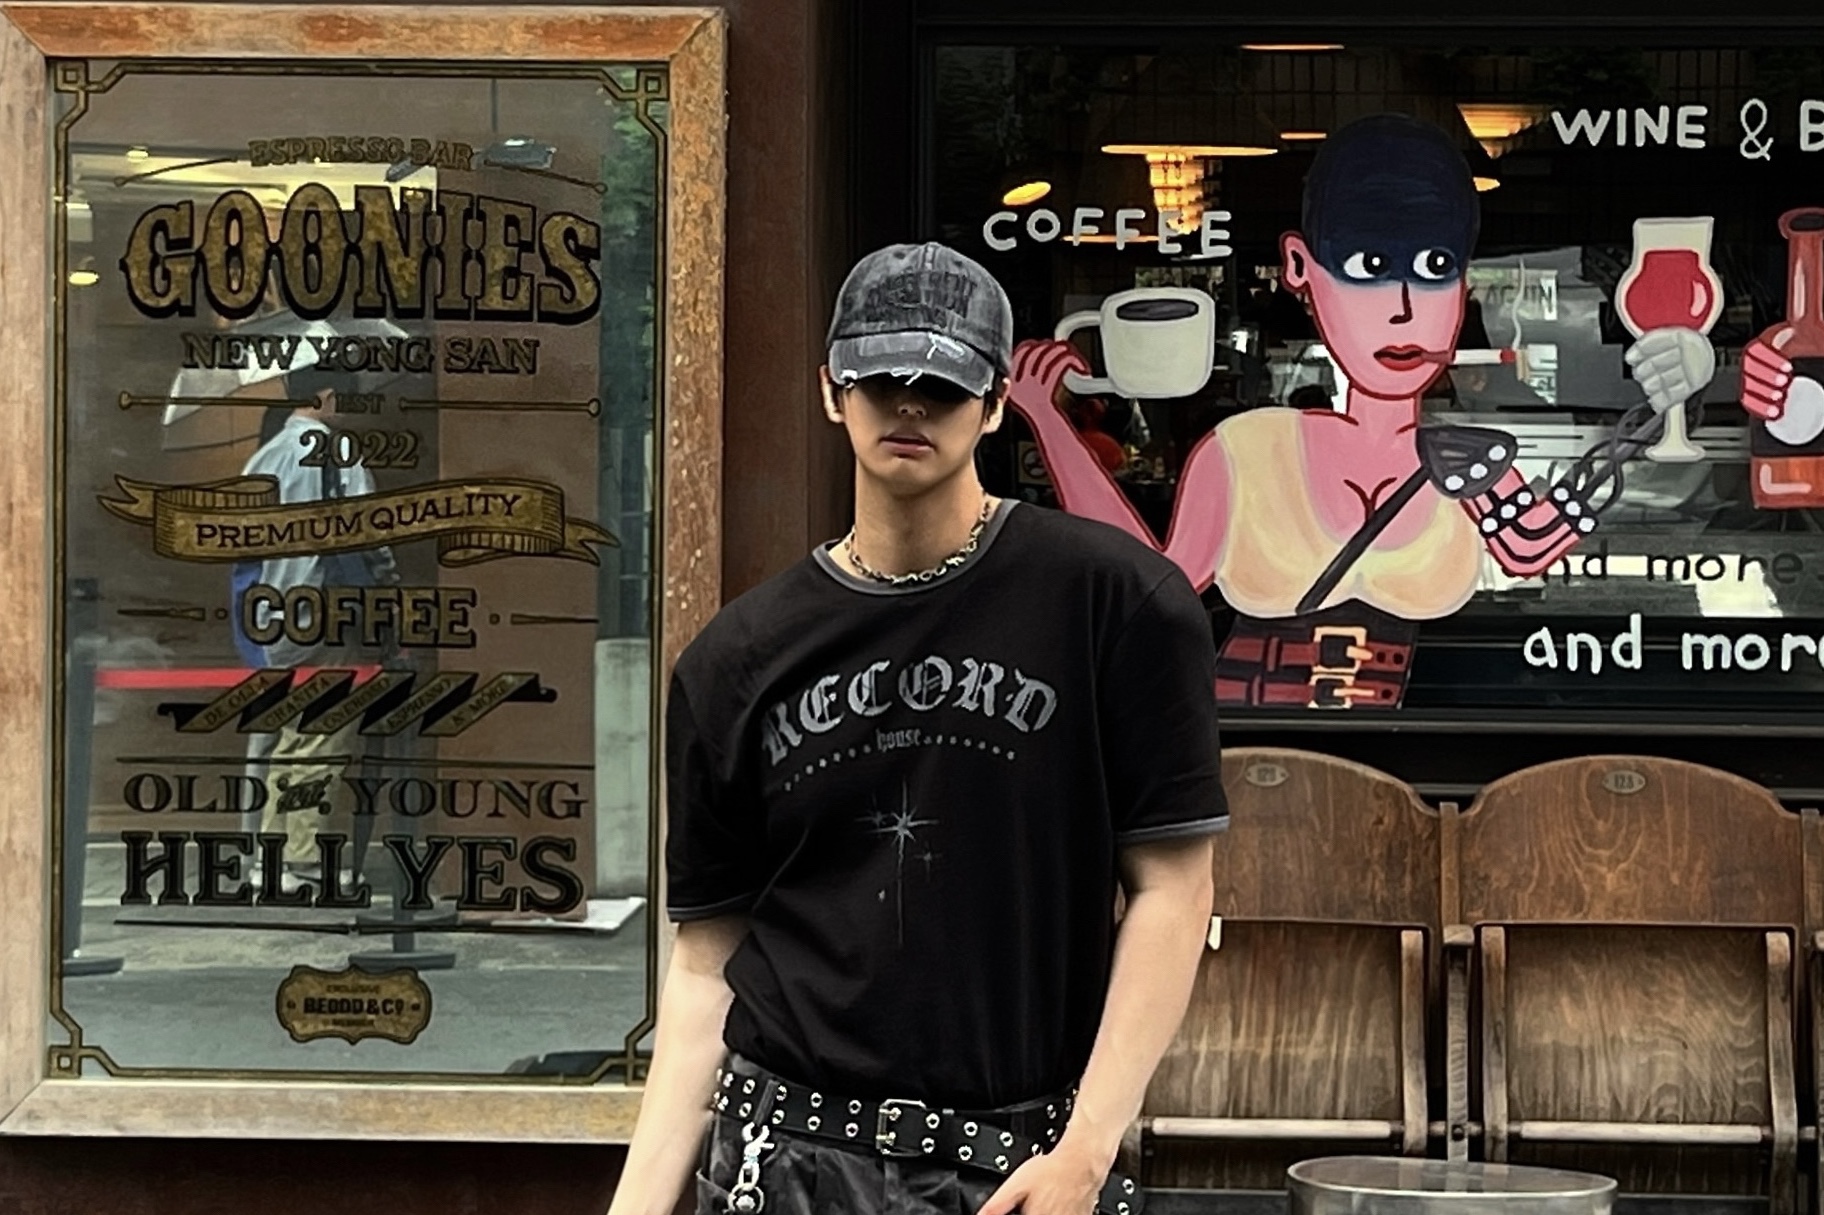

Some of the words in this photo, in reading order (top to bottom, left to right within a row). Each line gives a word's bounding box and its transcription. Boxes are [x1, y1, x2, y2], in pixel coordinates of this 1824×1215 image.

[248, 136, 405, 167] ESPRESSO
[410, 138, 474, 171] BAR
[1551, 105, 1708, 149] WINE
[1740, 98, 1774, 161] &
[118, 182, 601, 324] GOONIES
[983, 207, 1232, 256] COFFEE
[182, 333, 299, 371] NEW
[306, 336, 435, 373] YONG
[444, 338, 540, 374] SAN
[300, 429, 420, 468] 2022
[196, 510, 363, 548] PREMIUM
[369, 493, 521, 531] QUALITY
[241, 583, 478, 648] COFFEE
[1523, 613, 1642, 674] and
[1681, 632, 1824, 671] mor
[762, 655, 1057, 767] RECORD
[123, 773, 268, 813] OLD
[343, 777, 589, 819] YOUNG
[121, 831, 371, 908] HELL
[383, 834, 584, 914] YES
